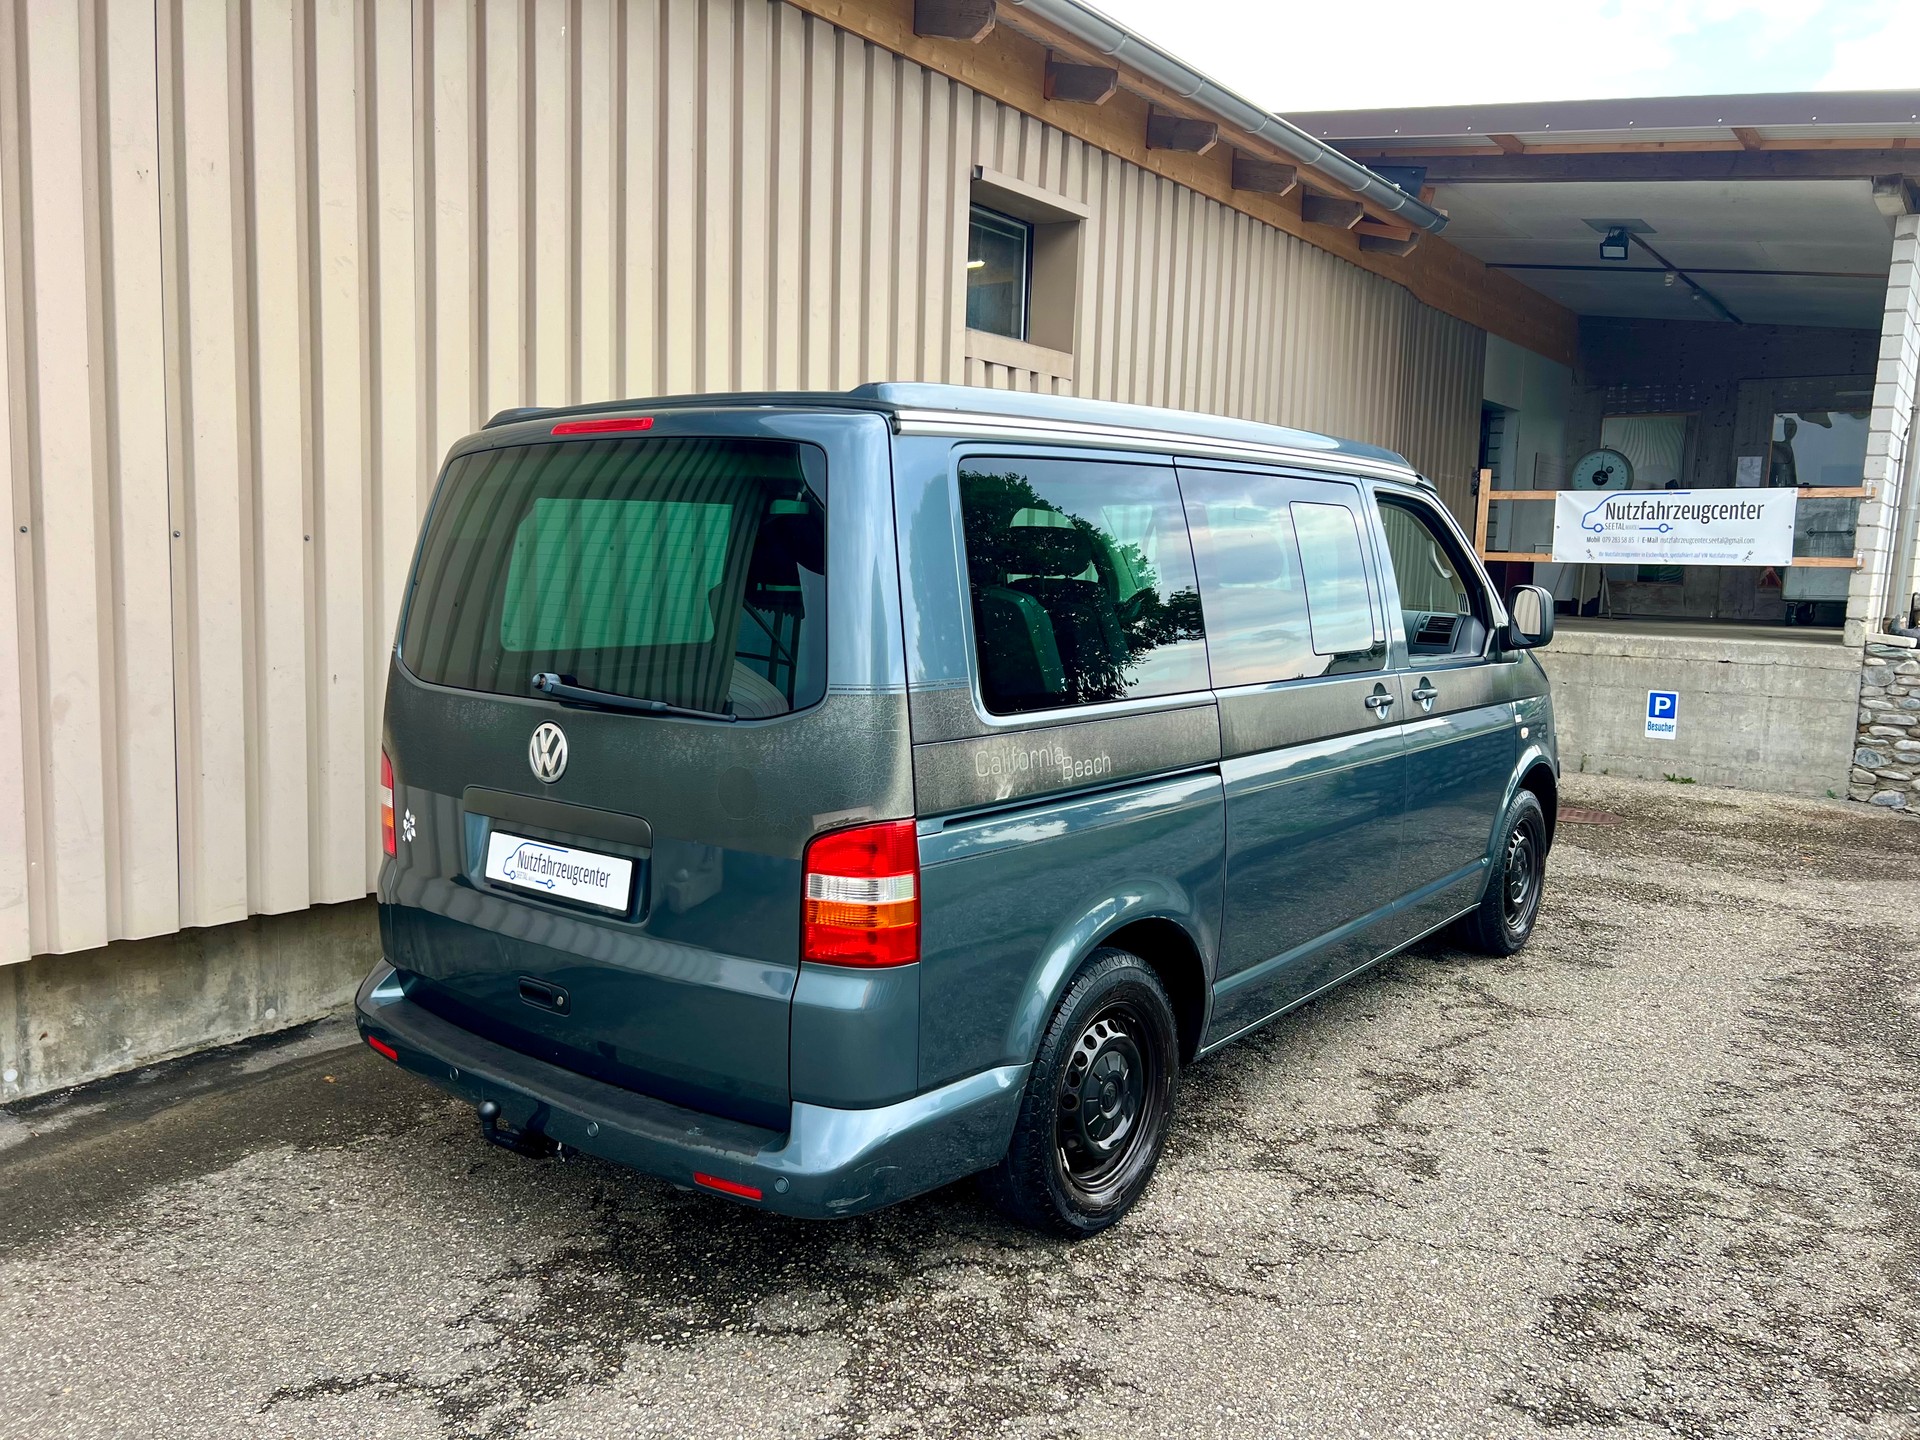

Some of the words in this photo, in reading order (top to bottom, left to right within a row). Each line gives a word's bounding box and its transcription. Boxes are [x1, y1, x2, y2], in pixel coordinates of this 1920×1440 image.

[1605, 501, 1765, 524] Nutzfahrzeugcenter
[1604, 523, 1625, 531] SEETAL
[1654, 696, 1672, 716] P
[1647, 720, 1675, 732] Besucher
[975, 742, 1064, 777] California
[1062, 751, 1112, 780] Beach
[516, 850, 611, 888] Nutzfahrzeugcenter
